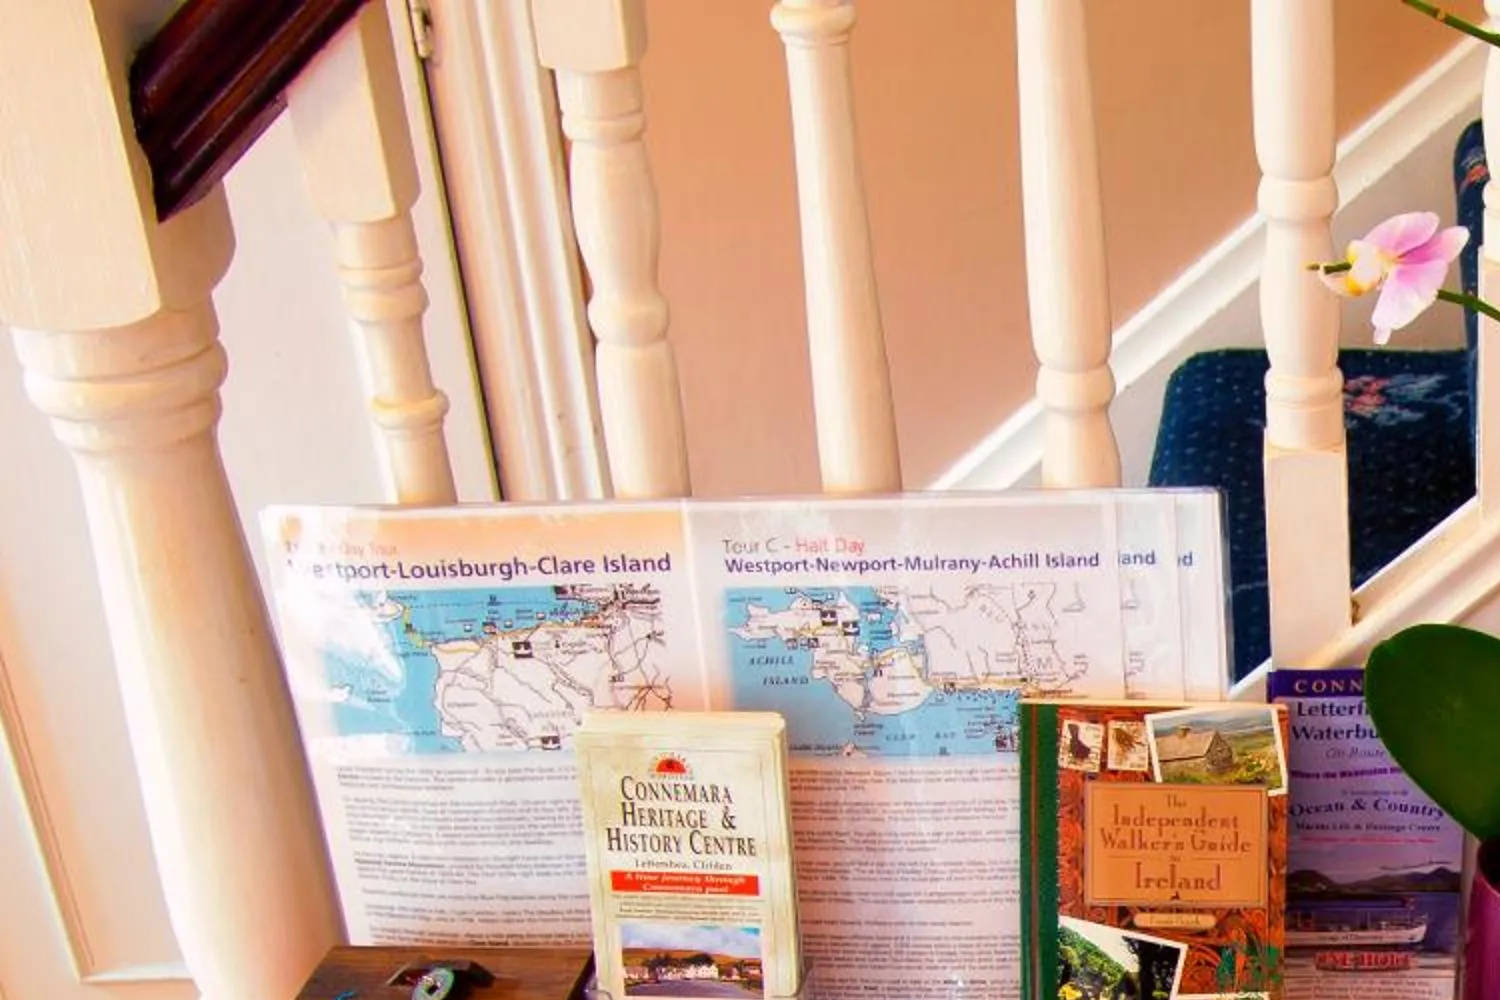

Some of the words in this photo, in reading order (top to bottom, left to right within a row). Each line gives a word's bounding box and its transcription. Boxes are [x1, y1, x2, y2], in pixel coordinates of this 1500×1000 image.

[722, 539, 759, 553] Tour
[766, 538, 779, 553] C
[834, 537, 865, 555] Day
[601, 552, 672, 573] Island
[724, 552, 1039, 576] Westport-Newport-Mulrany-Achill
[1045, 551, 1100, 569] Island
[1295, 680, 1364, 693] CONN
[621, 776, 733, 803] CONNEMARA
[1165, 794, 1187, 808] The
[621, 802, 708, 829] HERITAGE
[722, 807, 736, 829] &
[1113, 804, 1239, 837] Independent
[1290, 800, 1344, 817] Ocean
[1351, 799, 1367, 811] &
[1373, 799, 1444, 820] Country
[607, 828, 683, 851] HISTORY
[689, 830, 757, 857] CENTRE
[1100, 827, 1184, 852] Walker's
[1191, 831, 1252, 853] Guide
[1135, 861, 1221, 891] Ireland
